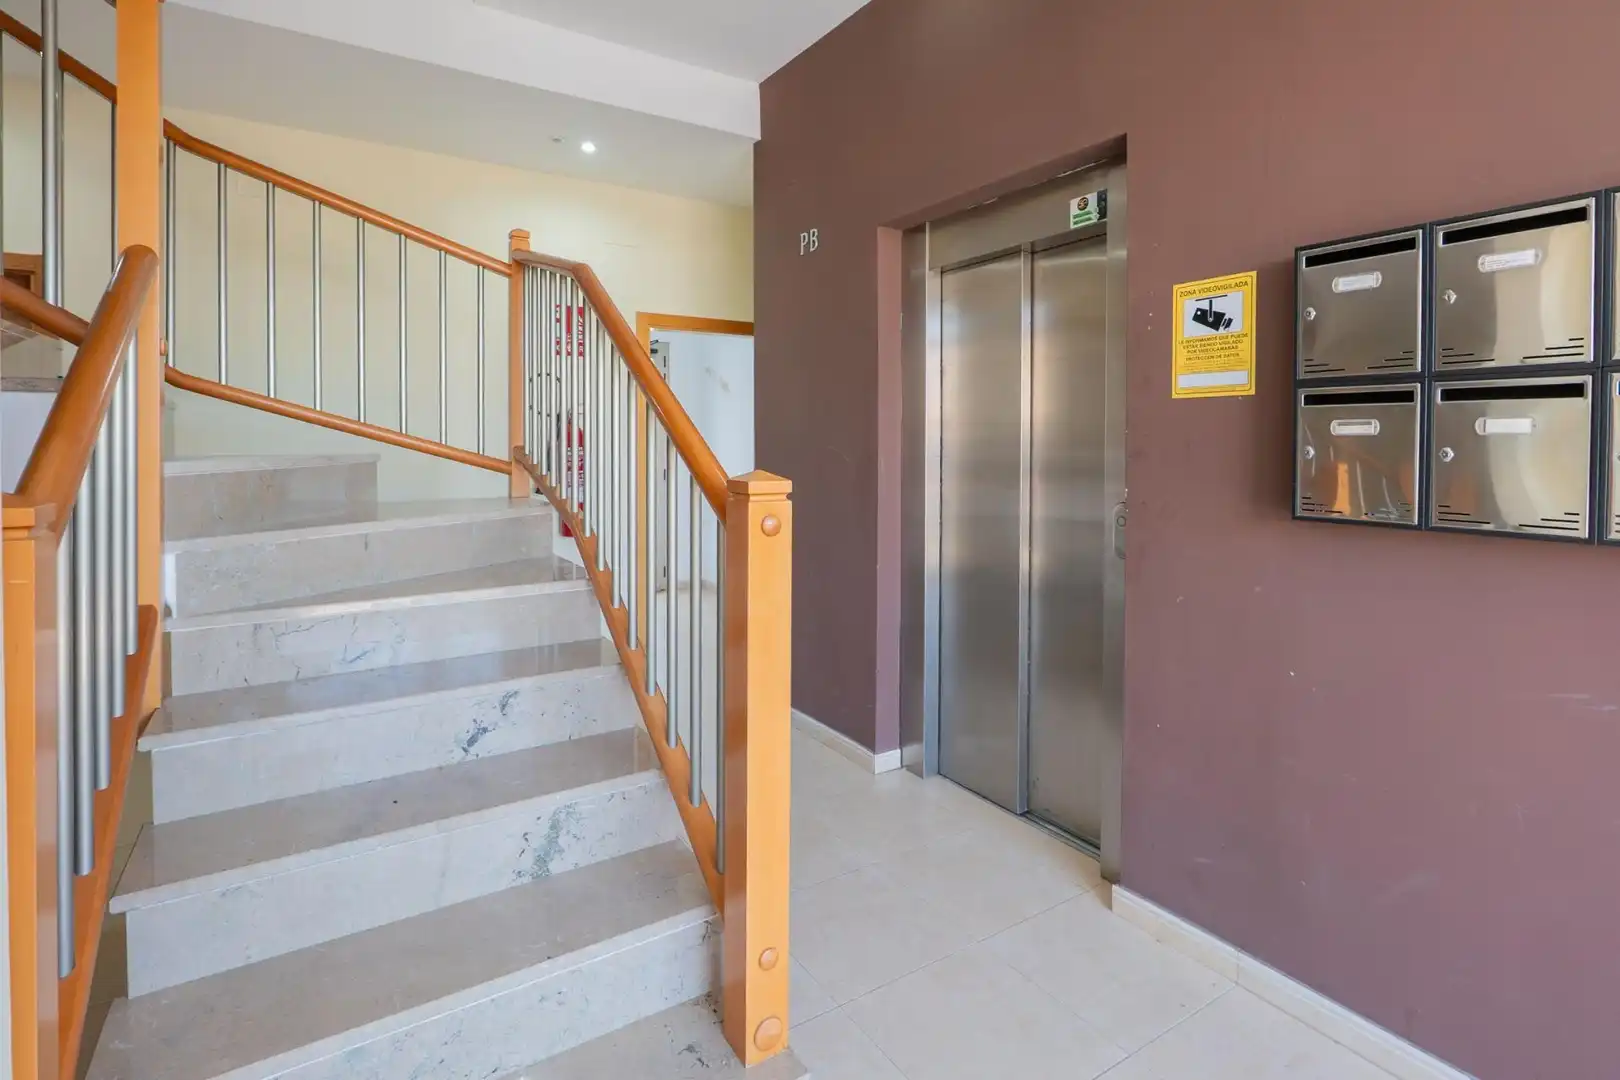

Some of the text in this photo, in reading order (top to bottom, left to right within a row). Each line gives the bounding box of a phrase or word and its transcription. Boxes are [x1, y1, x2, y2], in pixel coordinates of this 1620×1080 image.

[800, 228, 818, 256] PB
[1179, 280, 1249, 298] ZONA VIDEOVIGILADA
[1185, 335, 1218, 344] INFORMAMOS
